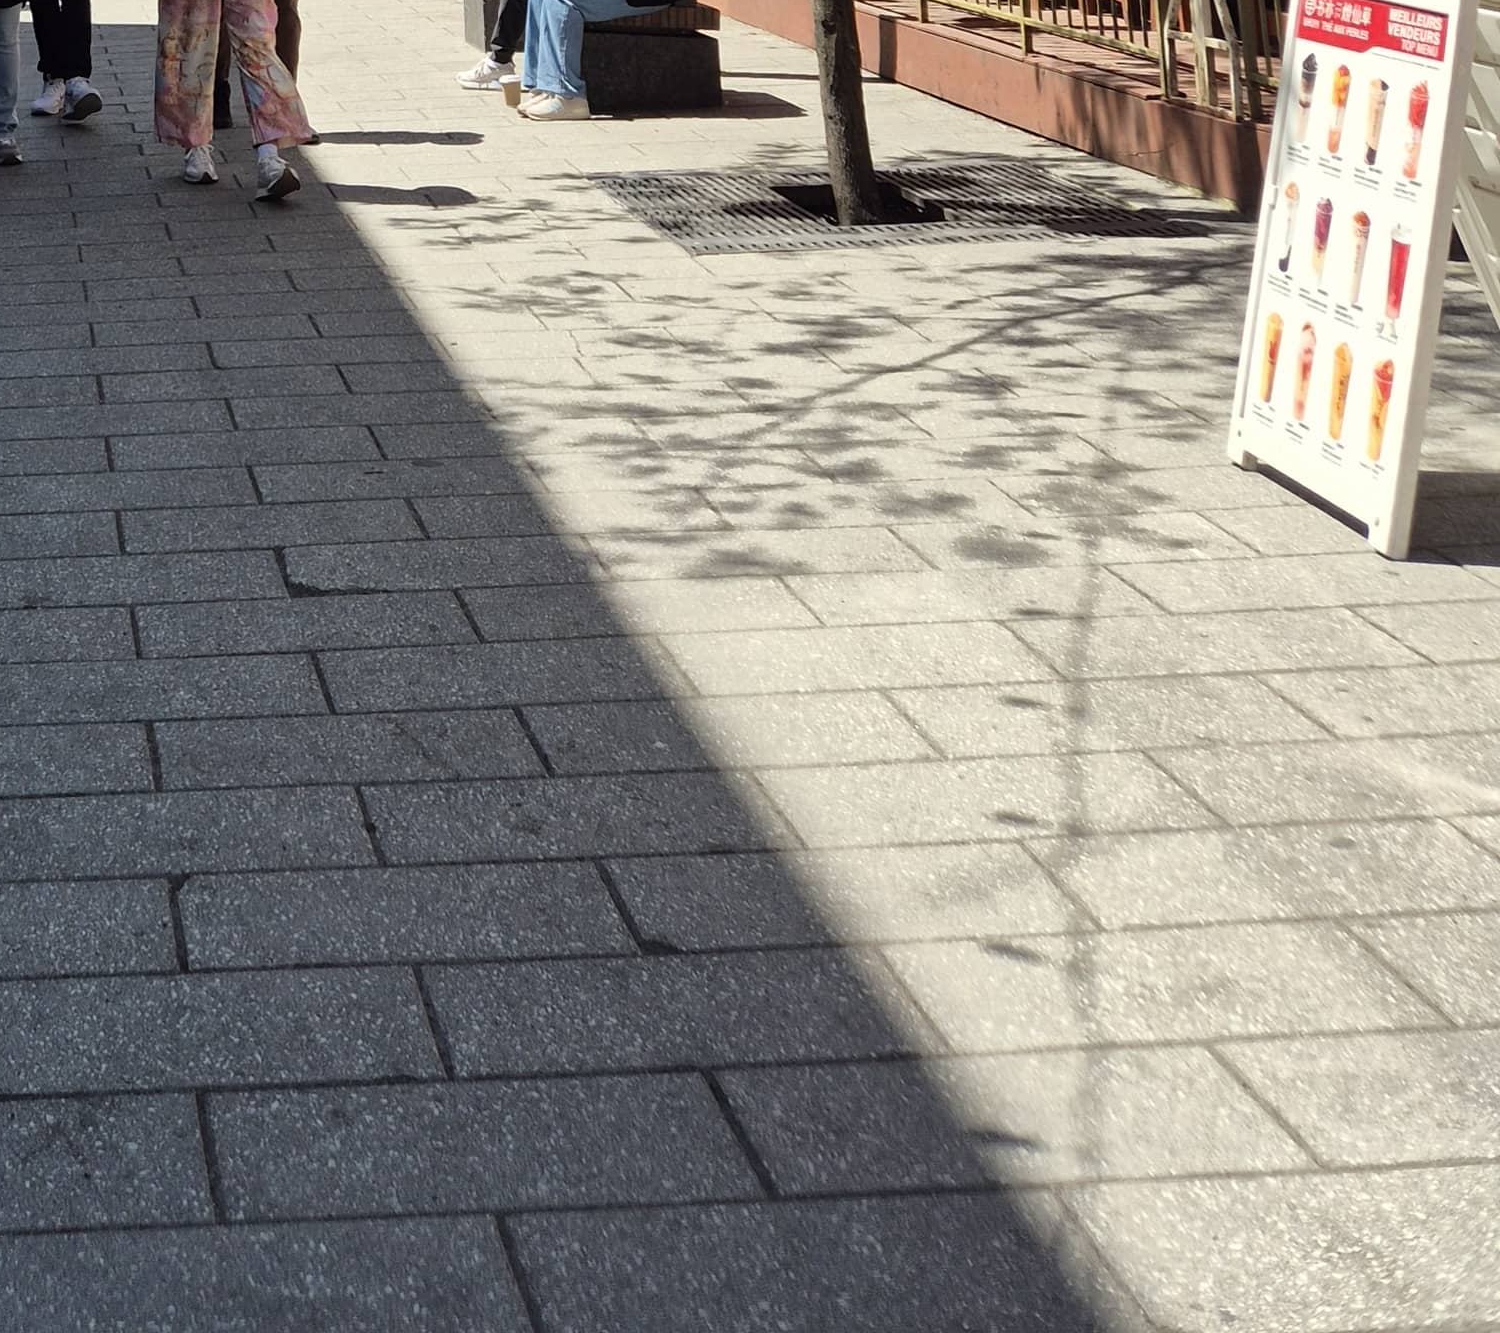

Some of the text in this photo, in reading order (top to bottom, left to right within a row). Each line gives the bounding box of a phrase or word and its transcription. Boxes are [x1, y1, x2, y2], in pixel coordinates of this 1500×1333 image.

[1389, 7, 1443, 31] MEILLEURS
[1387, 22, 1441, 46] VENDEURS
[1401, 38, 1416, 52] TOP
